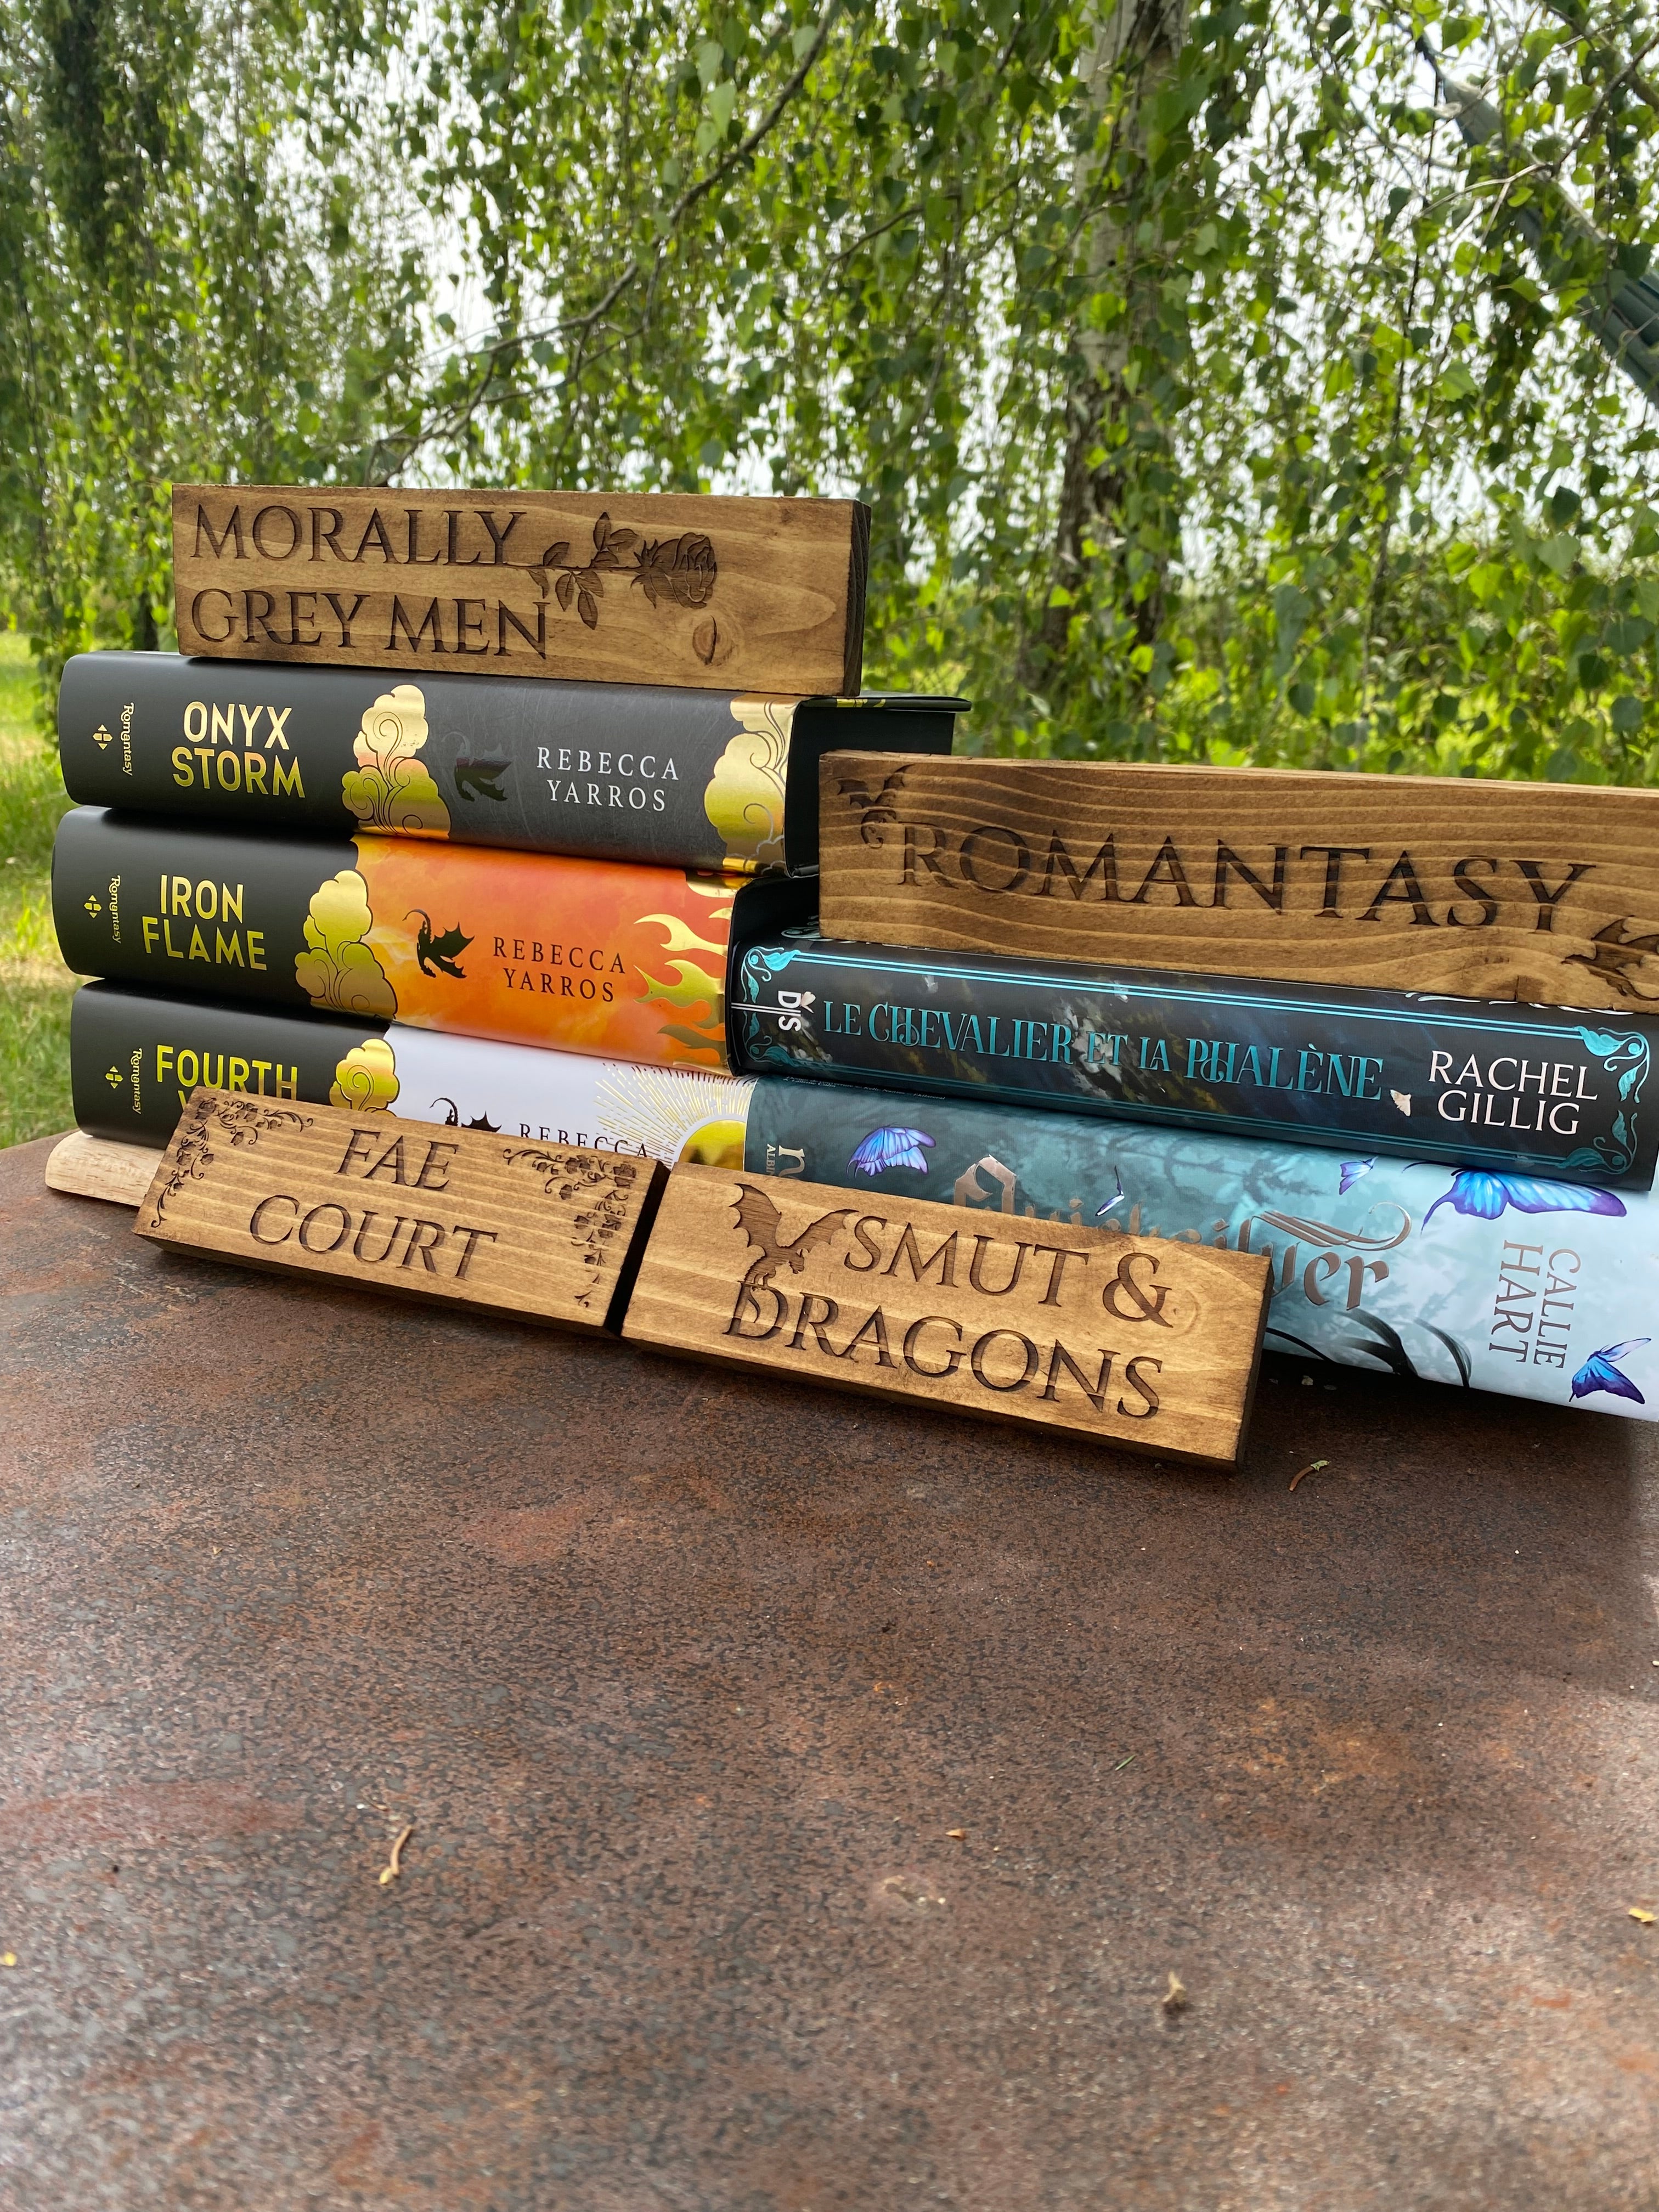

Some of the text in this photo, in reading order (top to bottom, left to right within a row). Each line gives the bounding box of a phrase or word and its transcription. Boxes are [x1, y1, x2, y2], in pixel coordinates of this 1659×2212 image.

[191, 504, 527, 566] MORALLY
[191, 588, 550, 660] GREY MEN
[120, 702, 134, 776] Romantasy
[183, 701, 293, 751] ONYX
[171, 746, 306, 799] STORM
[536, 747, 679, 780] REBECCA
[546, 779, 666, 812] YARROS
[160, 874, 244, 924] IRON
[896, 820, 1597, 934] ROMANTASY
[109, 874, 121, 944] Romantasy
[142, 916, 268, 971] FLAME
[492, 936, 627, 974] REBECCA
[503, 967, 614, 1002] YARROS
[130, 1047, 142, 1115] Romantasy
[157, 1045, 297, 1101] FOURTH
[823, 1001, 1384, 1101] LE CHEVALIER ET LA PHALÈNE
[1428, 1049, 1598, 1101] RACHEL
[520, 1123, 648, 1158] REBECCA
[1437, 1090, 1581, 1136] GILLIG
[334, 1128, 460, 1192] FAE
[249, 1194, 498, 1279] COURT
[843, 1215, 1090, 1307] SMUT
[1102, 1251, 1173, 1328] &
[1488, 1239, 1543, 1363] HART
[1533, 1248, 1581, 1368] CALLIE
[722, 1280, 1164, 1419] DRAGONS
